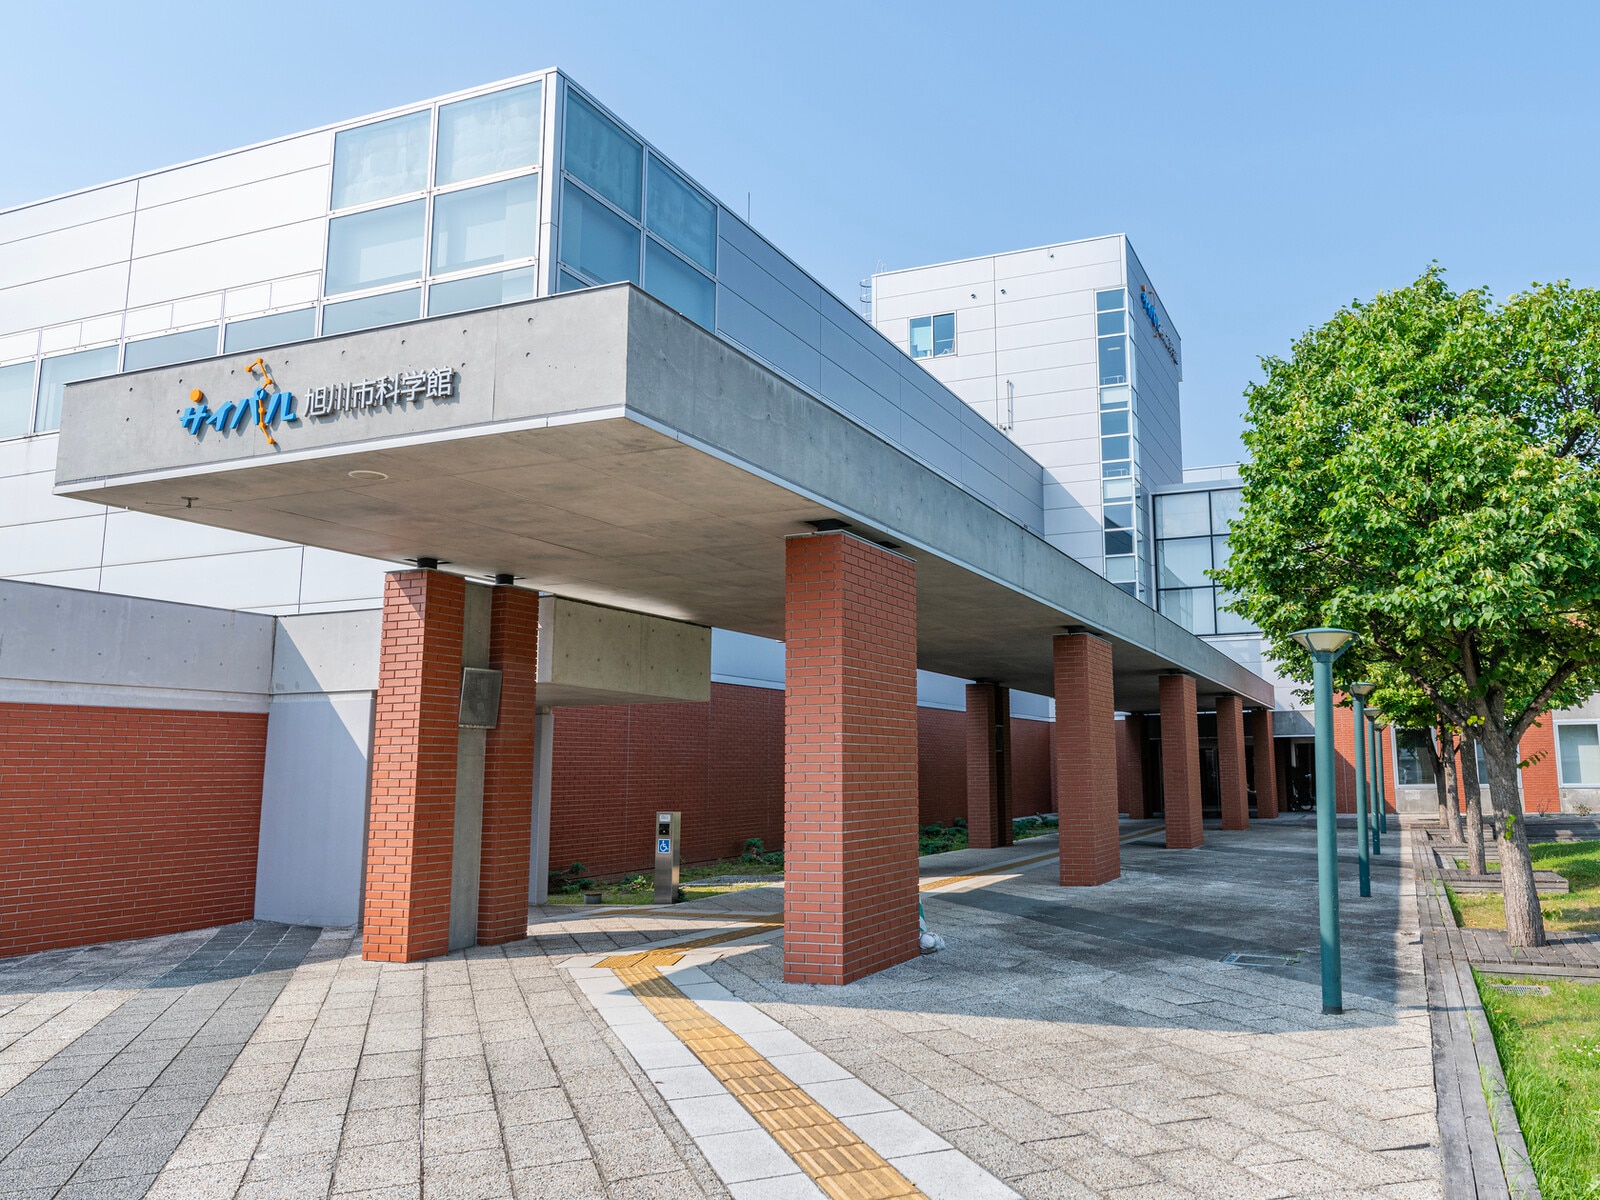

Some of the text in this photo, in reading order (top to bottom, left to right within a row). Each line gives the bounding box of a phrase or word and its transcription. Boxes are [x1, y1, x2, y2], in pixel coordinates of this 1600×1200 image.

[180, 366, 454, 435] サイパル 旭川市科学館
